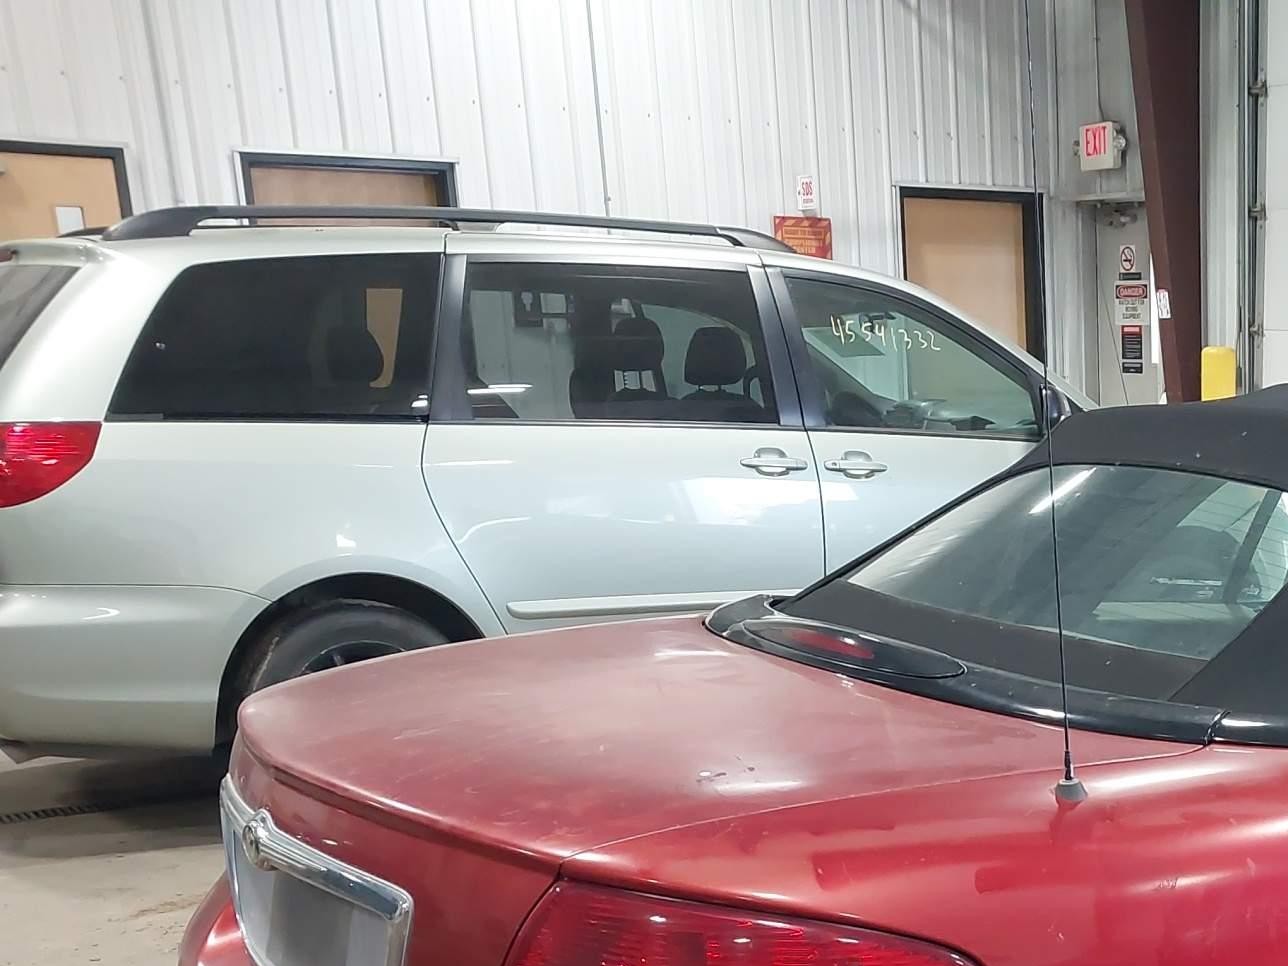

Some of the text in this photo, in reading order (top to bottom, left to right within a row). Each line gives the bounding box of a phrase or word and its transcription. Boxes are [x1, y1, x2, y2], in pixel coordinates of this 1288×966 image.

[1084, 126, 1107, 157] EXIT
[801, 181, 813, 196] SDS
[830, 315, 941, 351] 45541332
